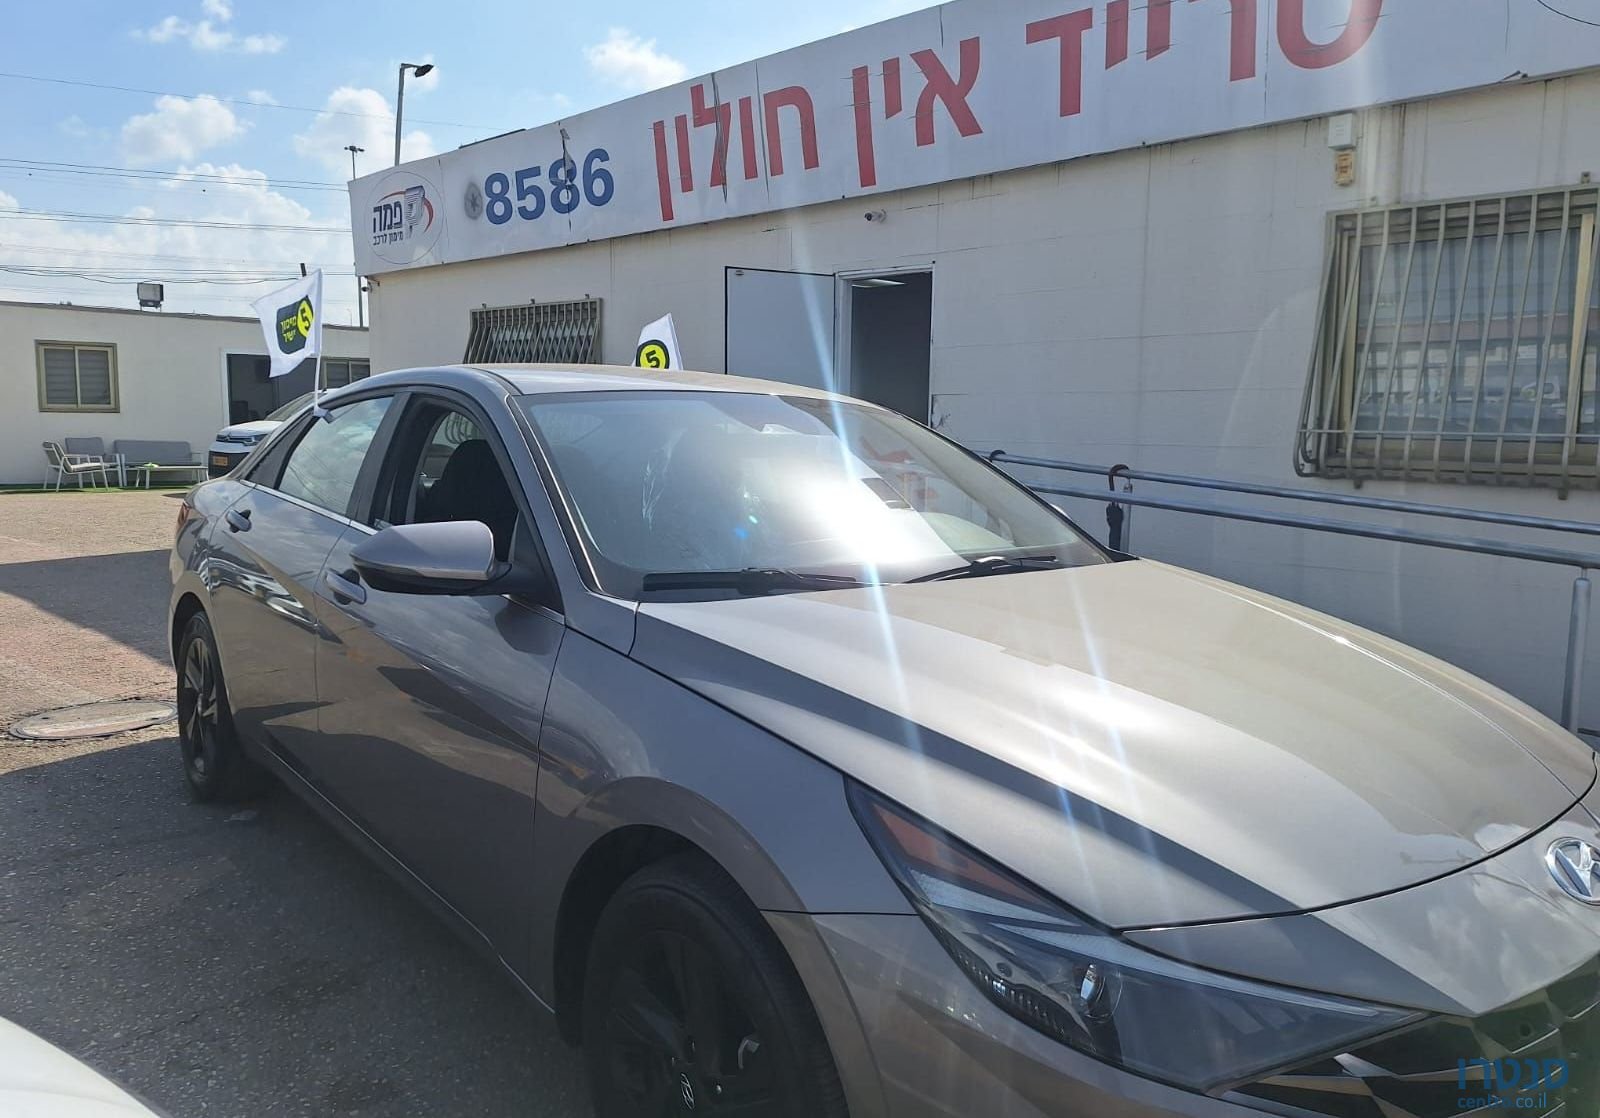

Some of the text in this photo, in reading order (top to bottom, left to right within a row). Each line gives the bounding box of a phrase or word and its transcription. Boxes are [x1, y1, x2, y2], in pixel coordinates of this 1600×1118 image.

[852, 36, 983, 187] אין
[653, 83, 819, 221] חולון
[373, 201, 403, 233] פמה
[373, 231, 403, 246] מימון לרכב
[300, 307, 311, 332] 5
[645, 350, 660, 369] 5
